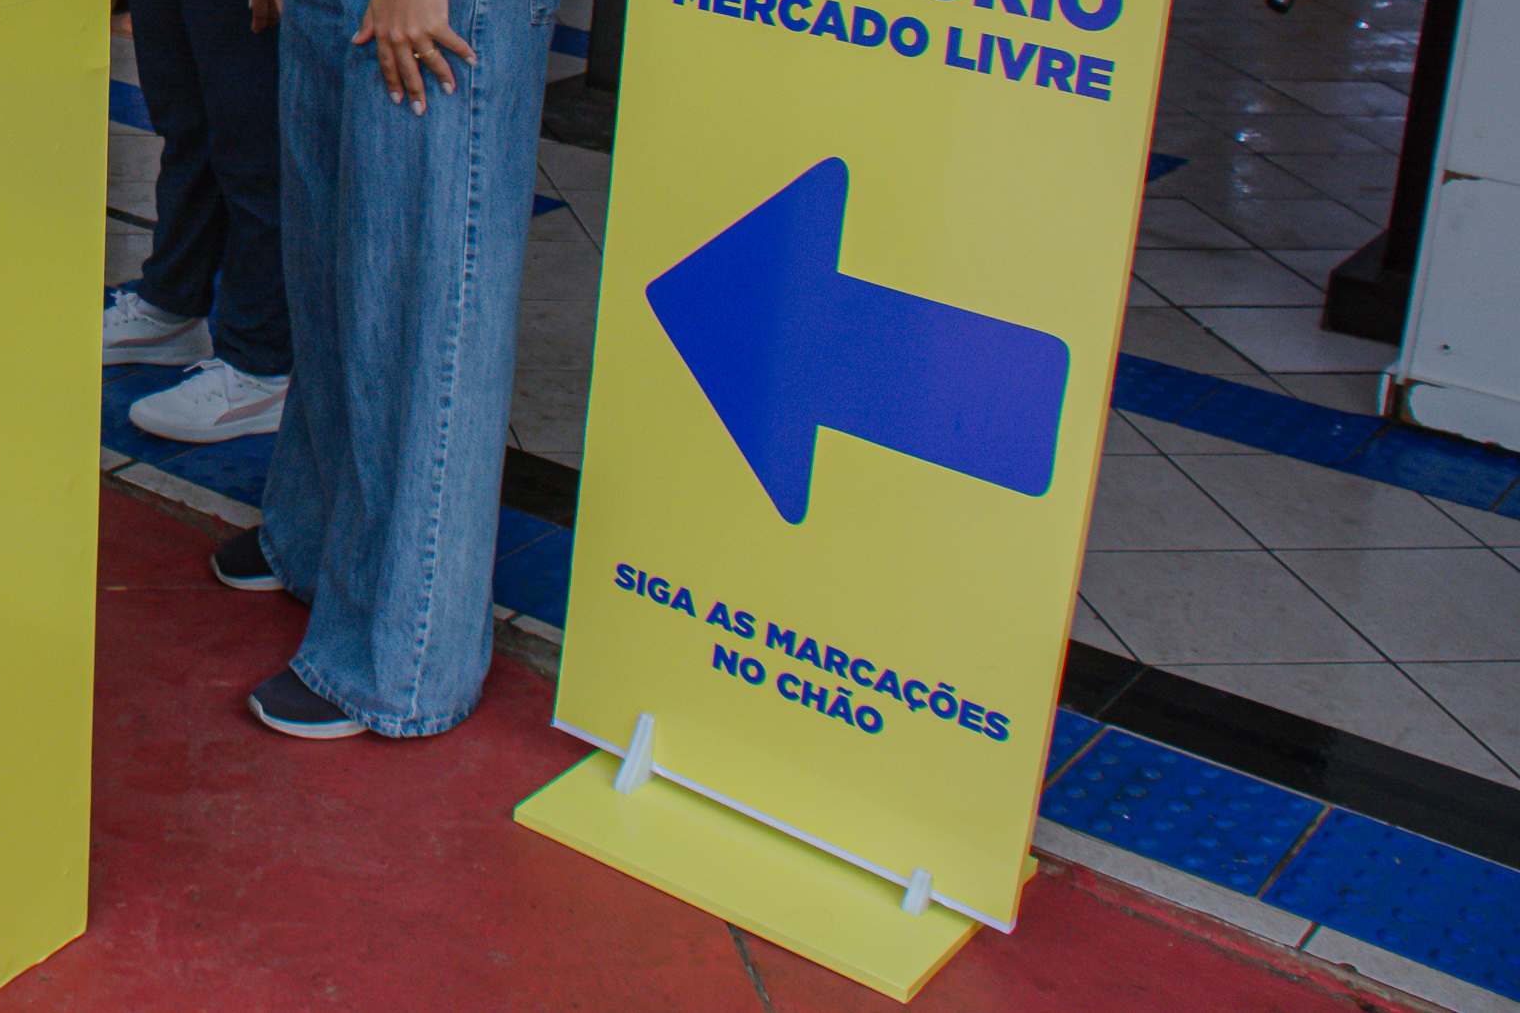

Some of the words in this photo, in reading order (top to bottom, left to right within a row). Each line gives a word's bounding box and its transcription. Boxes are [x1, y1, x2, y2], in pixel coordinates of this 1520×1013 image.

[945, 26, 1115, 101] LIVRE
[615, 563, 695, 616] SIGA
[707, 602, 754, 638] AS
[766, 622, 1010, 742] MARCAÇÕES
[712, 643, 765, 685] NO
[776, 672, 884, 735] CHÃO
